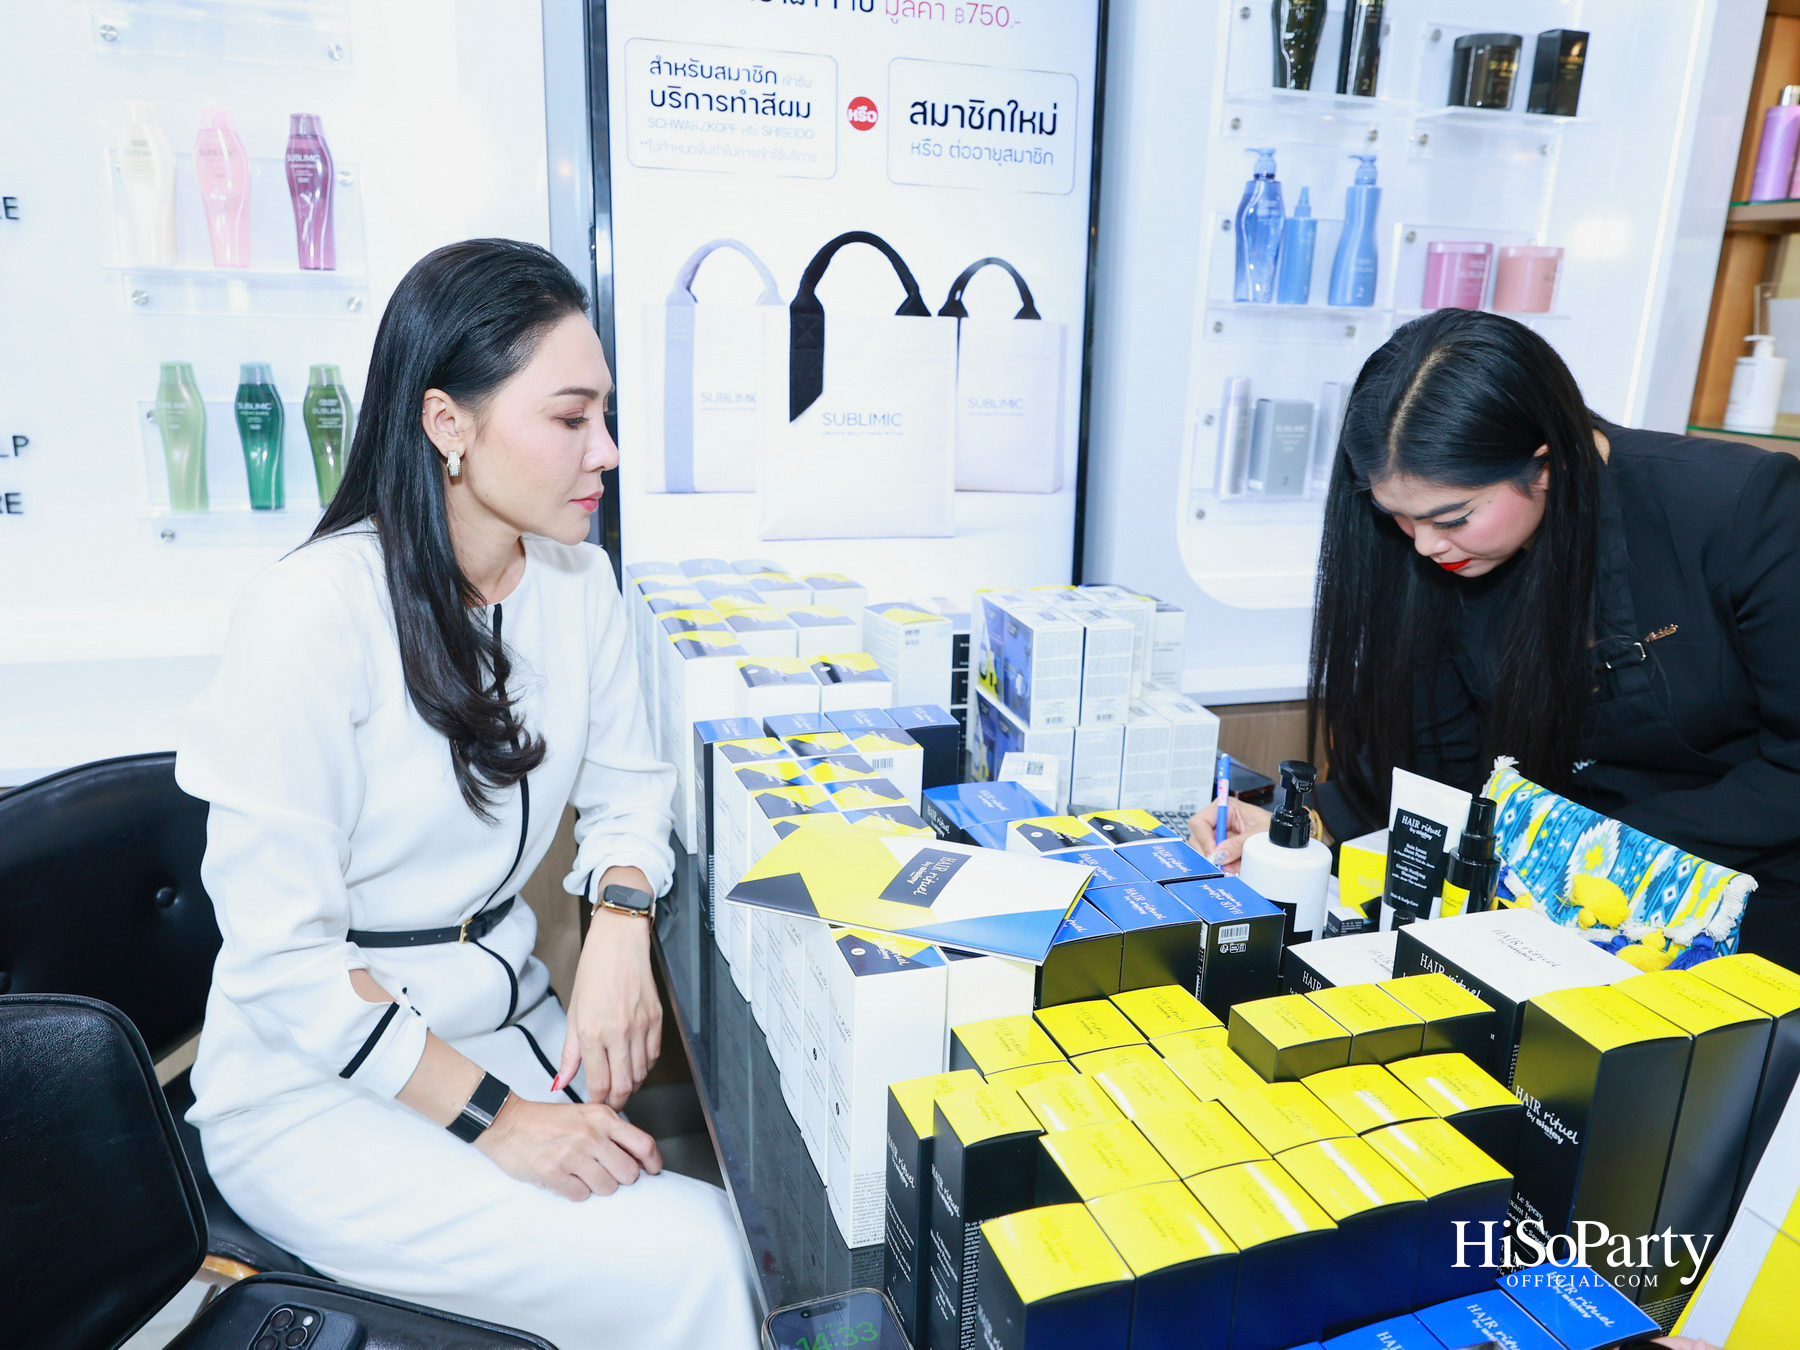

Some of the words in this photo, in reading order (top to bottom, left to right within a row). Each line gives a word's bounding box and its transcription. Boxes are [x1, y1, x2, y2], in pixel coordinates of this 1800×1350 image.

[649, 55, 777, 85] สำหรับสมาชิก
[650, 85, 811, 118] บริการทำสีผม
[848, 104, 878, 124] หรือ
[648, 117, 737, 134] SCHWARZKOPF
[762, 127, 814, 140] SHISEIDO
[909, 99, 1057, 136] สมาชิกใหม่
[911, 138, 943, 157] หรือ
[949, 140, 1054, 167] ต่ออายุสมาชิก
[0, 196, 20, 220] E
[967, 397, 1025, 410] SUBLIMIC
[822, 412, 903, 427] SUBLIMIC
[0, 493, 24, 514] E
[1401, 815, 1421, 829] HAIR
[1420, 823, 1442, 837] rituel
[931, 856, 957, 872] HAIR
[913, 871, 940, 896] rituel
[1123, 887, 1146, 902] HAIR
[1066, 916, 1088, 933] ituel
[1492, 929, 1523, 946] HAIR
[1520, 945, 1562, 969] rituel
[1515, 1085, 1541, 1115] HAIR
[1543, 1112, 1579, 1145] rituel
[1526, 1109, 1535, 1123] by
[1536, 1118, 1564, 1145] sisley
[1516, 1192, 1525, 1203] Le
[1525, 1200, 1544, 1220] Spray
[1546, 1270, 1579, 1295] HAIR
[1575, 1293, 1619, 1328] rituel
[796, 1321, 879, 1350] 14:33
[1466, 1304, 1499, 1329] HAIR
[1496, 1329, 1521, 1350] ritu
[1376, 1331, 1405, 1350] HAI
